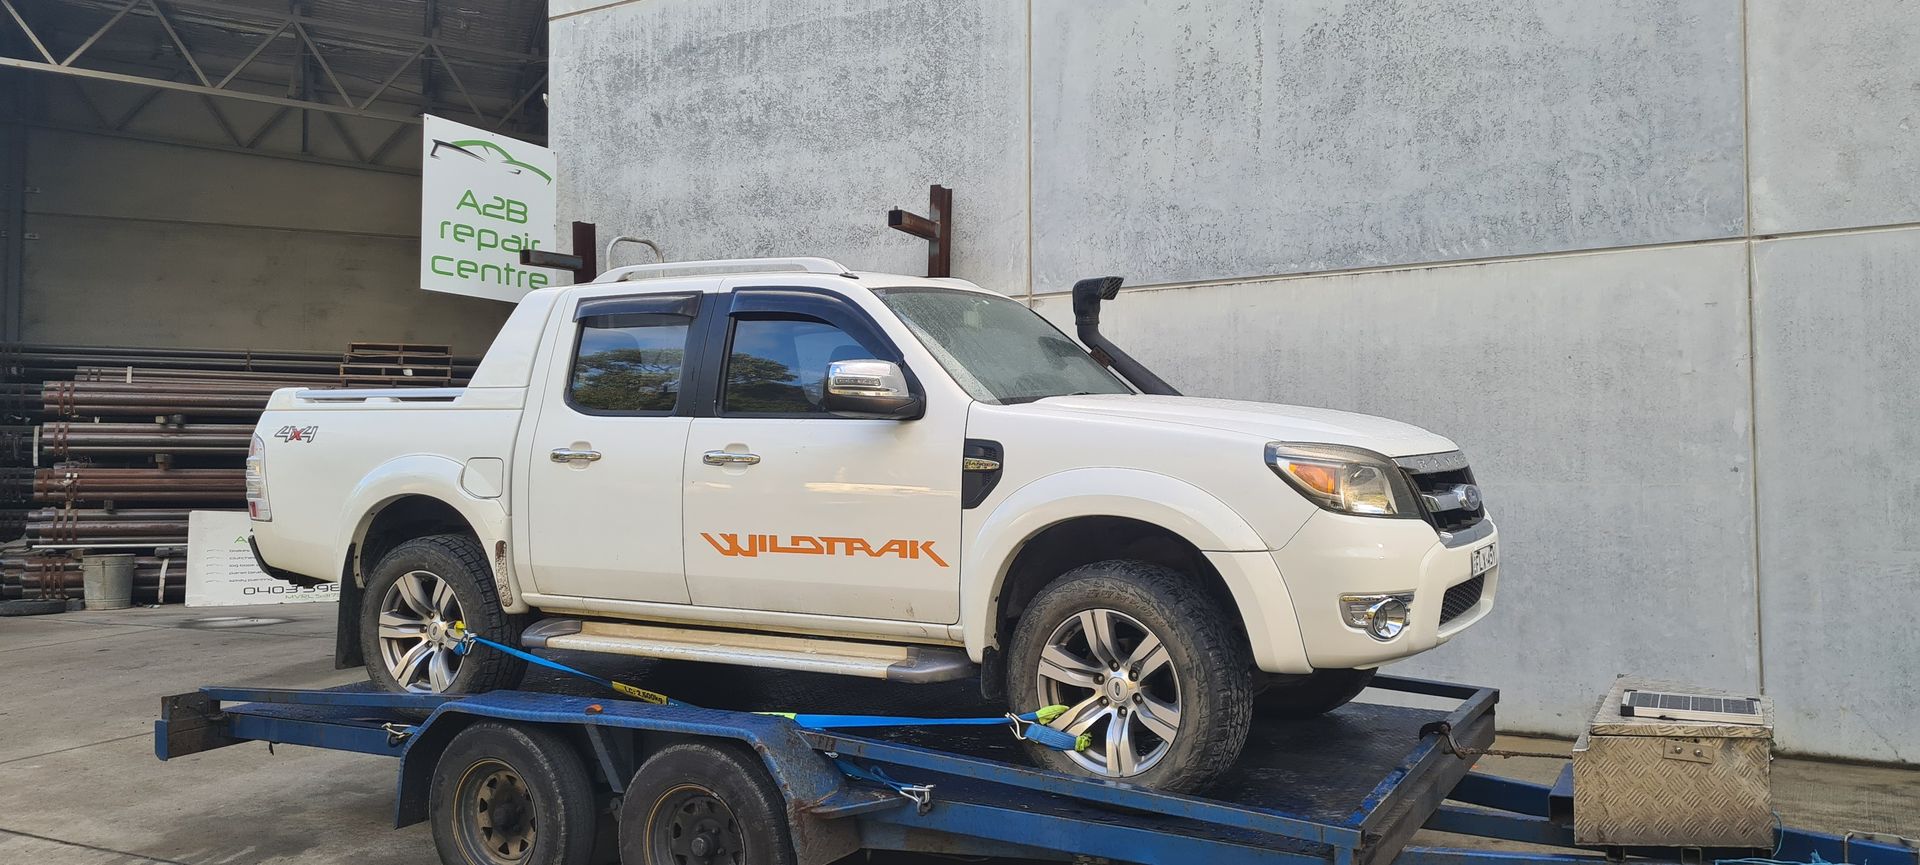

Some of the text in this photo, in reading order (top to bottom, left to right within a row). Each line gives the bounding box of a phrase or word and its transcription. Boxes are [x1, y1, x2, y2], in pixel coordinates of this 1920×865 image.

[456, 189, 528, 224] A2B
[440, 220, 541, 253] repair
[431, 255, 548, 289] centre
[274, 425, 319, 443] 4x4
[700, 532, 950, 568] WILDTRAK
[243, 586, 298, 596] 0403
